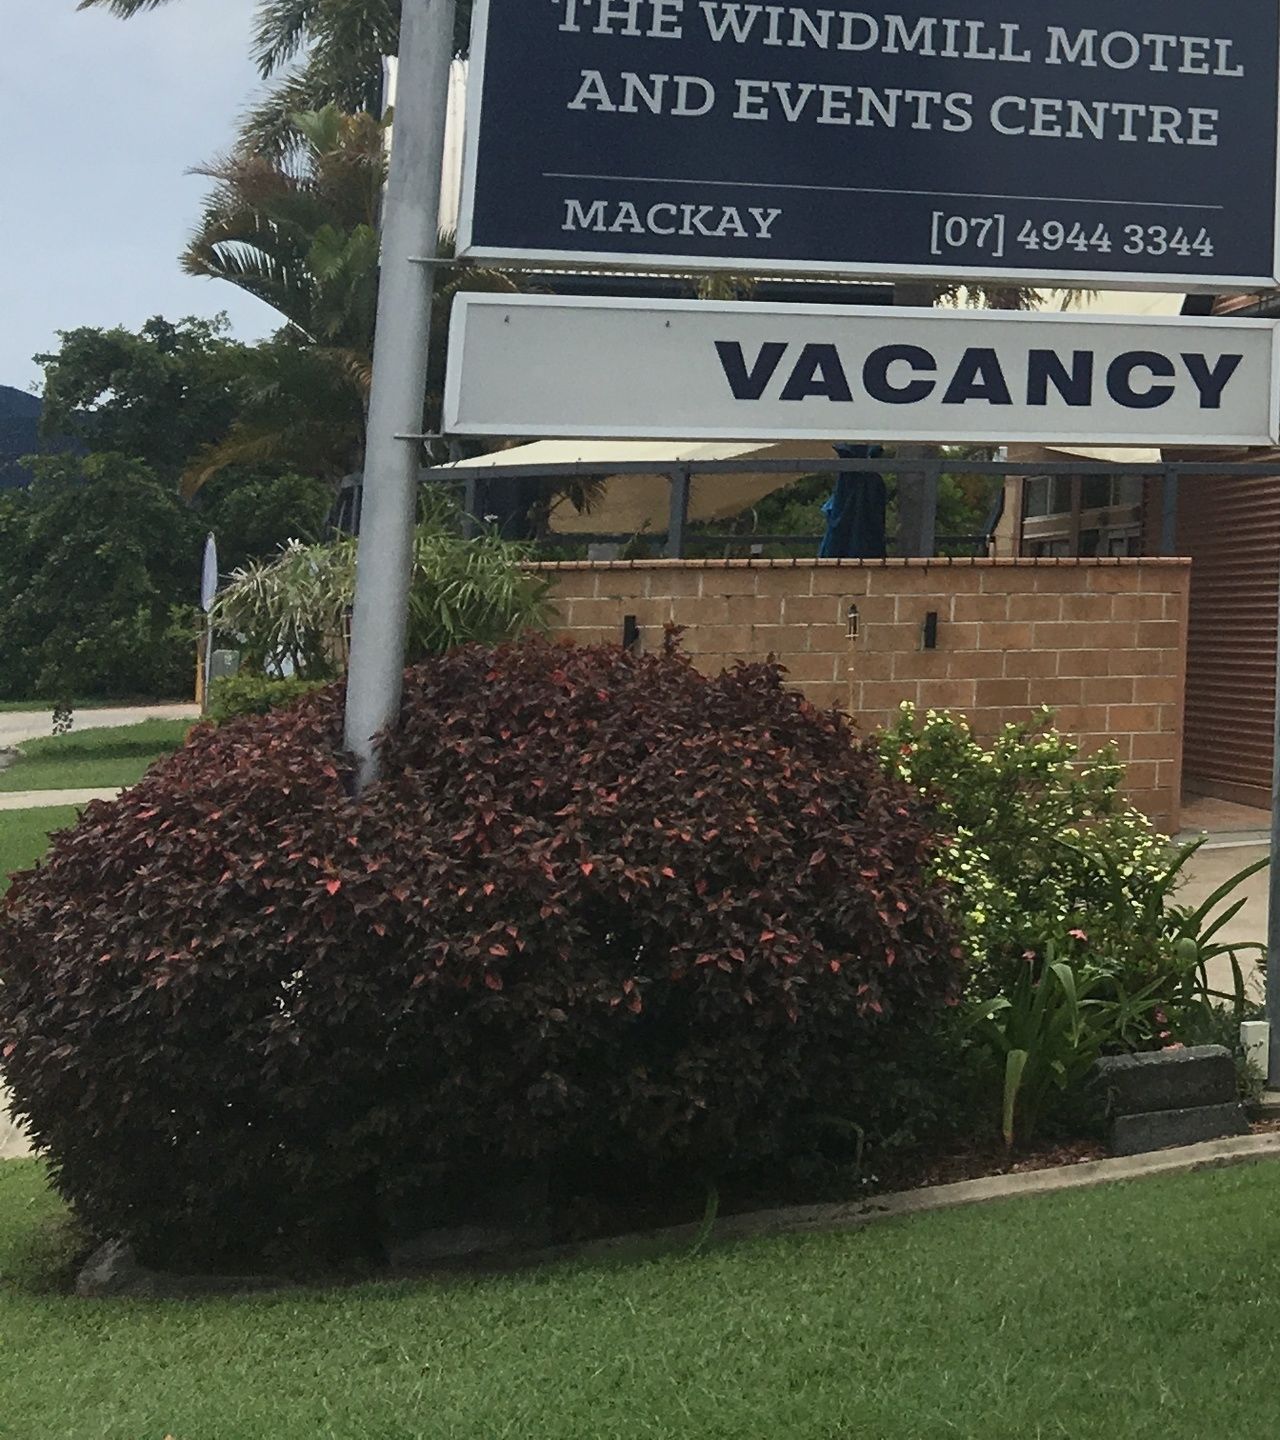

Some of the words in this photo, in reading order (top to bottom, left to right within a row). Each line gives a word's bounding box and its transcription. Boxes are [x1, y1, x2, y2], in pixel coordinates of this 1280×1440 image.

[698, 1, 1031, 63] WINDMILL
[1045, 26, 1244, 77] MOTEL
[567, 70, 715, 116] AND
[732, 79, 973, 132] EVENTS
[990, 95, 1219, 146] CENTRE
[561, 199, 782, 239] MACKAY
[931, 211, 1005, 257] [07]
[1016, 219, 1112, 253] 4944
[1123, 224, 1214, 257] 3344
[714, 340, 1243, 410] VACANCY
